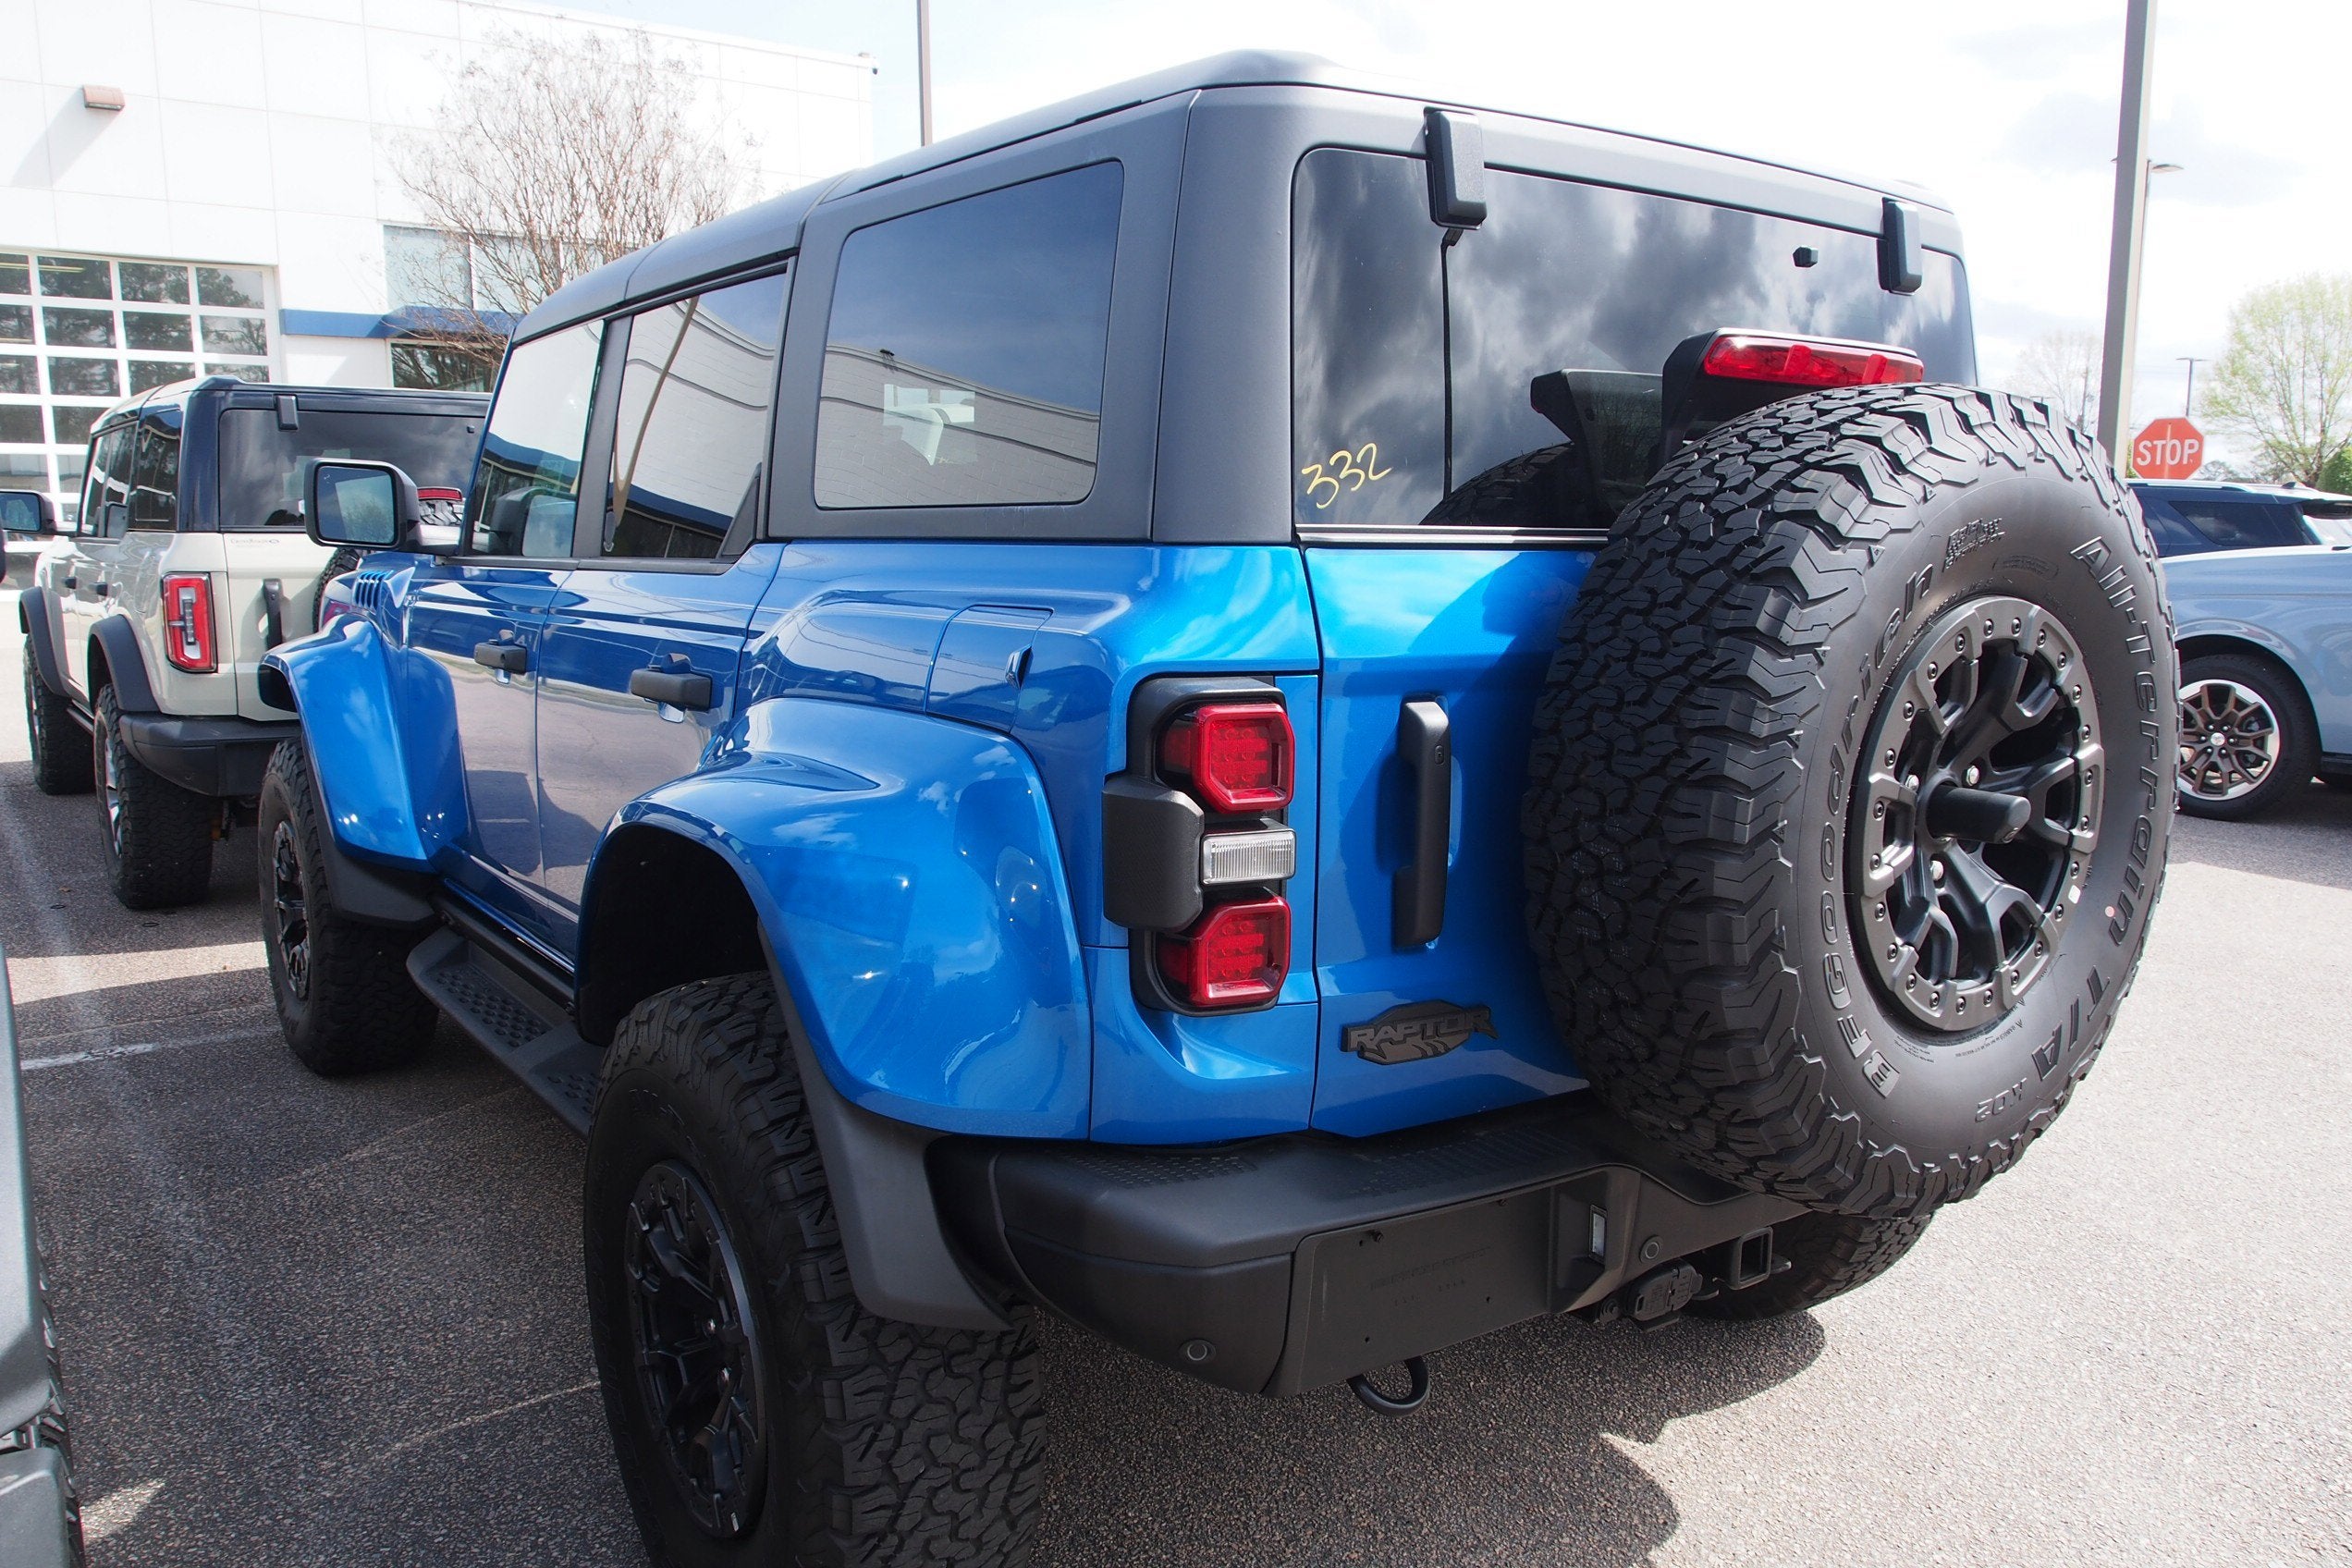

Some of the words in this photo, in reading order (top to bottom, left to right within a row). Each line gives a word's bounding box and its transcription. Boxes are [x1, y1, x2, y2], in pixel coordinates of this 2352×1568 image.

[1301, 443, 1393, 509] 332
[2137, 439, 2199, 466] STOP
[1349, 1005, 1499, 1060] RAPTOR
[2032, 965, 2111, 1081] T/A
